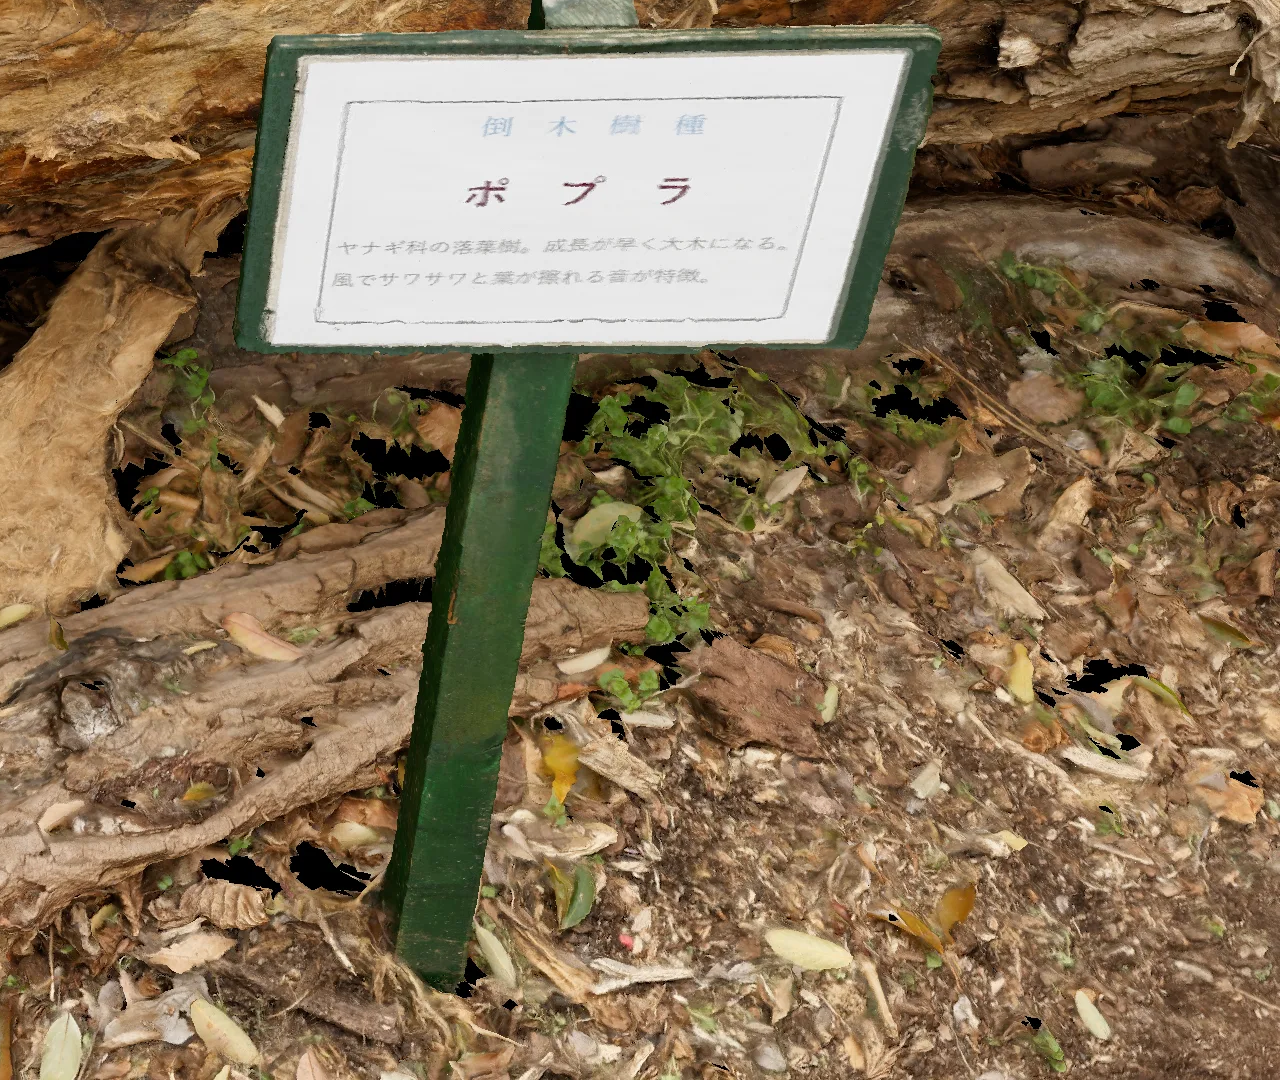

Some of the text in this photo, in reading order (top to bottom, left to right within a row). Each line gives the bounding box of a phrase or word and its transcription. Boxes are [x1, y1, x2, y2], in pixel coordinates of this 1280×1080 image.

[480, 113, 708, 138] 倒木樹種
[464, 175, 692, 208] ポプラ
